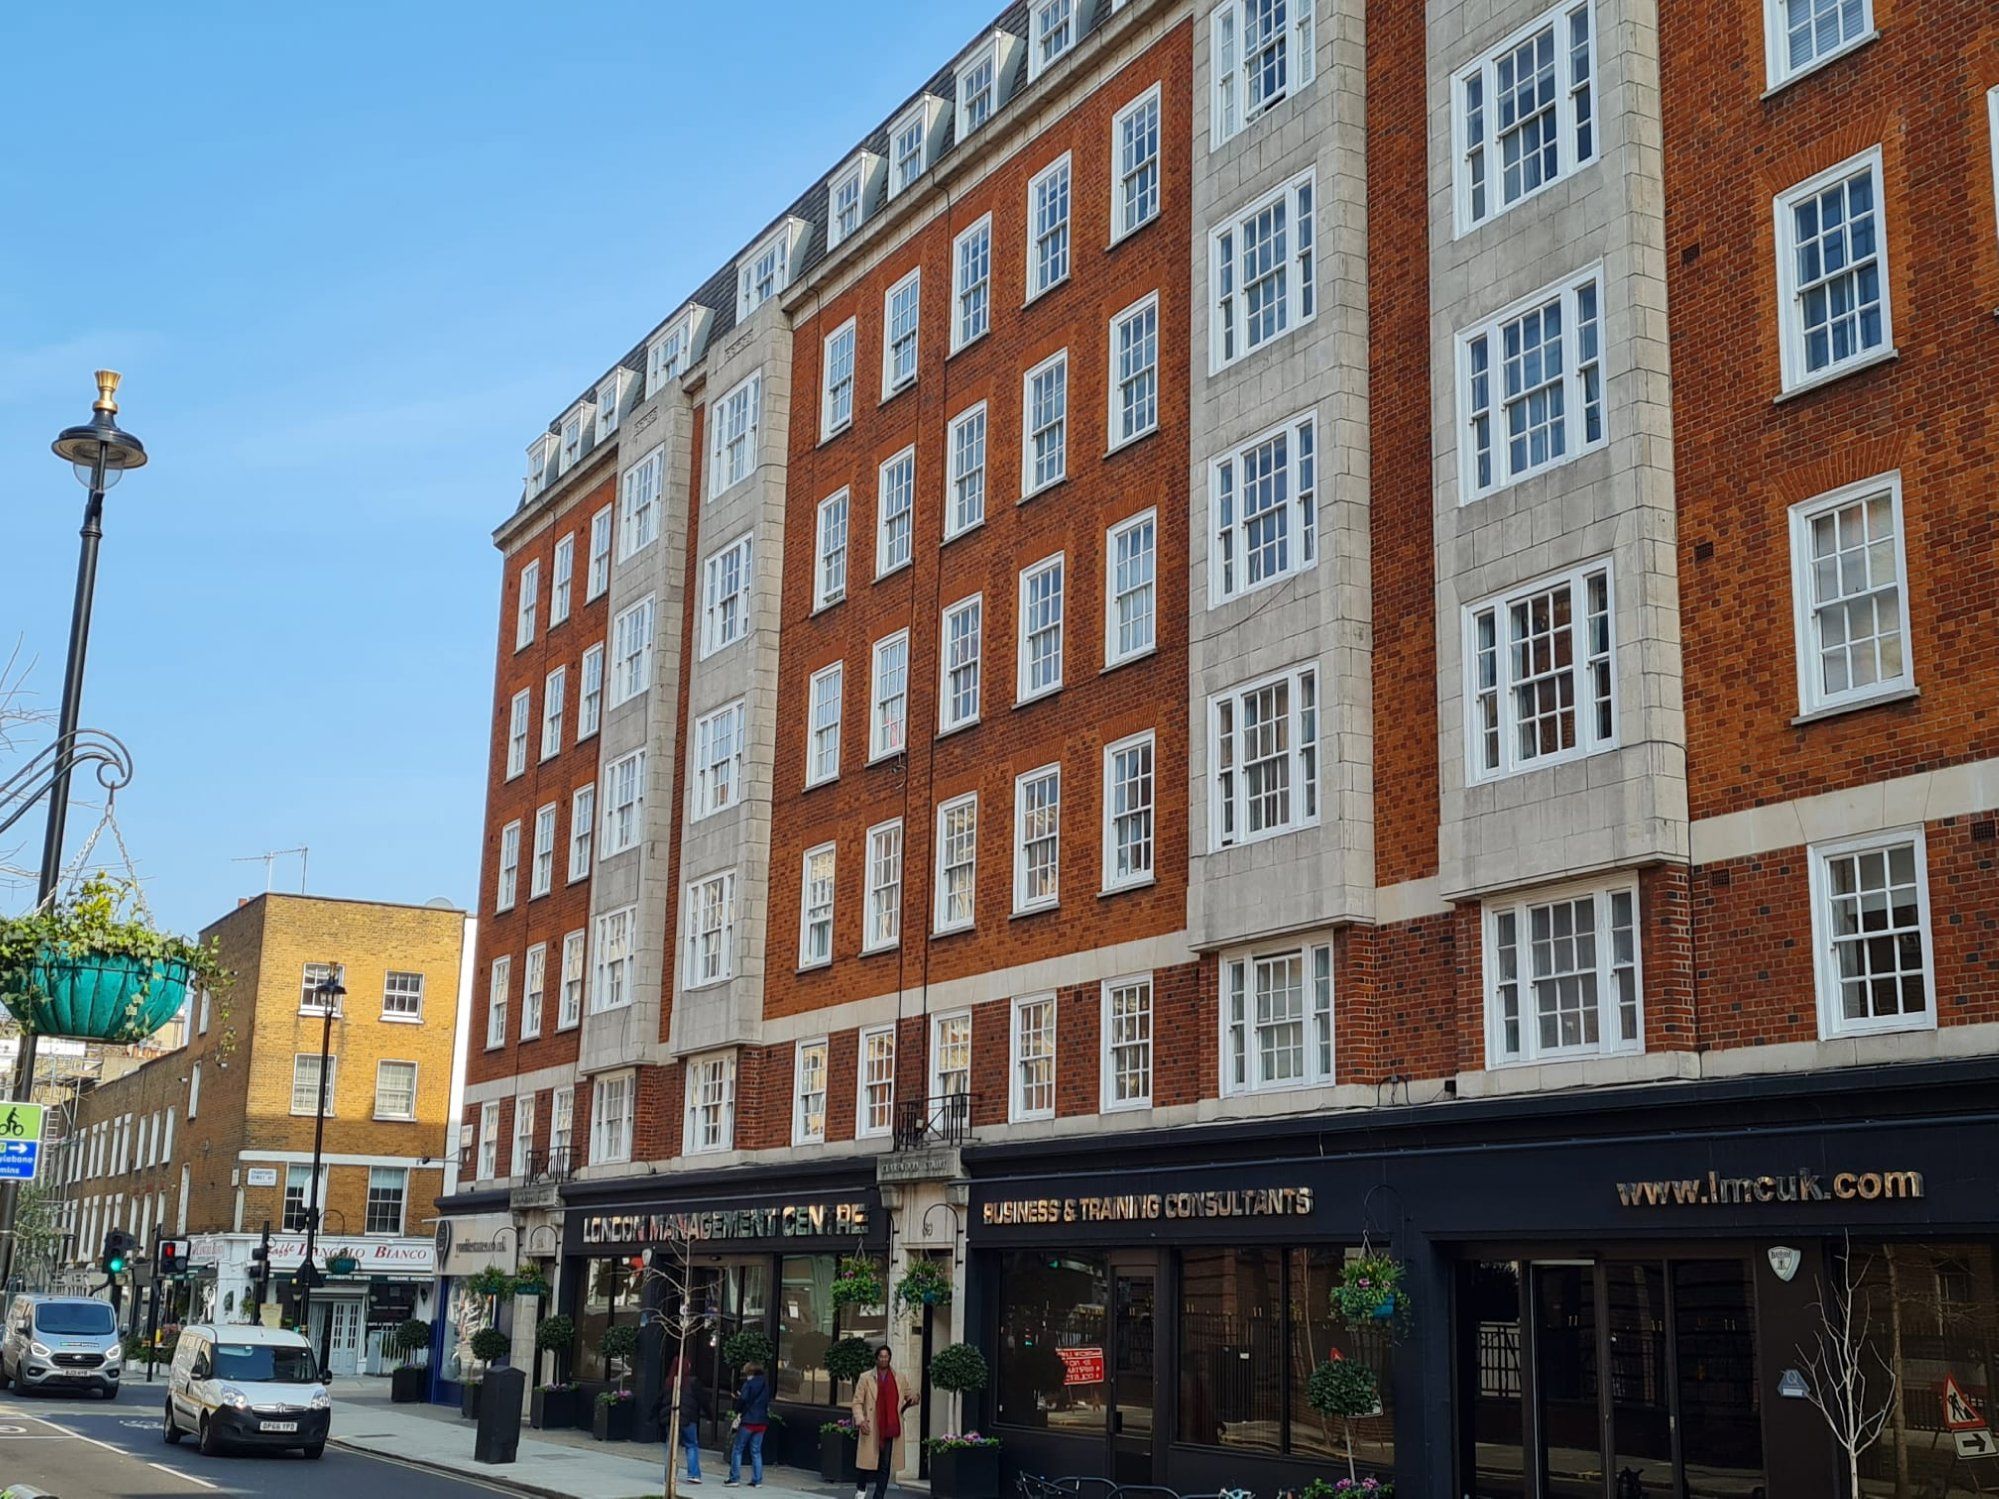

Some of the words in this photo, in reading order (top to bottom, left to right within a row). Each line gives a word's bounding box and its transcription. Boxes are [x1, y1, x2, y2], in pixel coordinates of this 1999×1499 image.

[1616, 1168, 1925, 1206] www.lmcuk.com
[983, 1199, 1060, 1225] BUSINESS
[1063, 1199, 1076, 1222] &
[1079, 1194, 1160, 1221] TRAINING
[1165, 1187, 1315, 1219] CONSULTANTS
[583, 1214, 645, 1243] LONDON
[650, 1208, 780, 1242] MANAGEMENT
[374, 1245, 427, 1260] BIANCO
